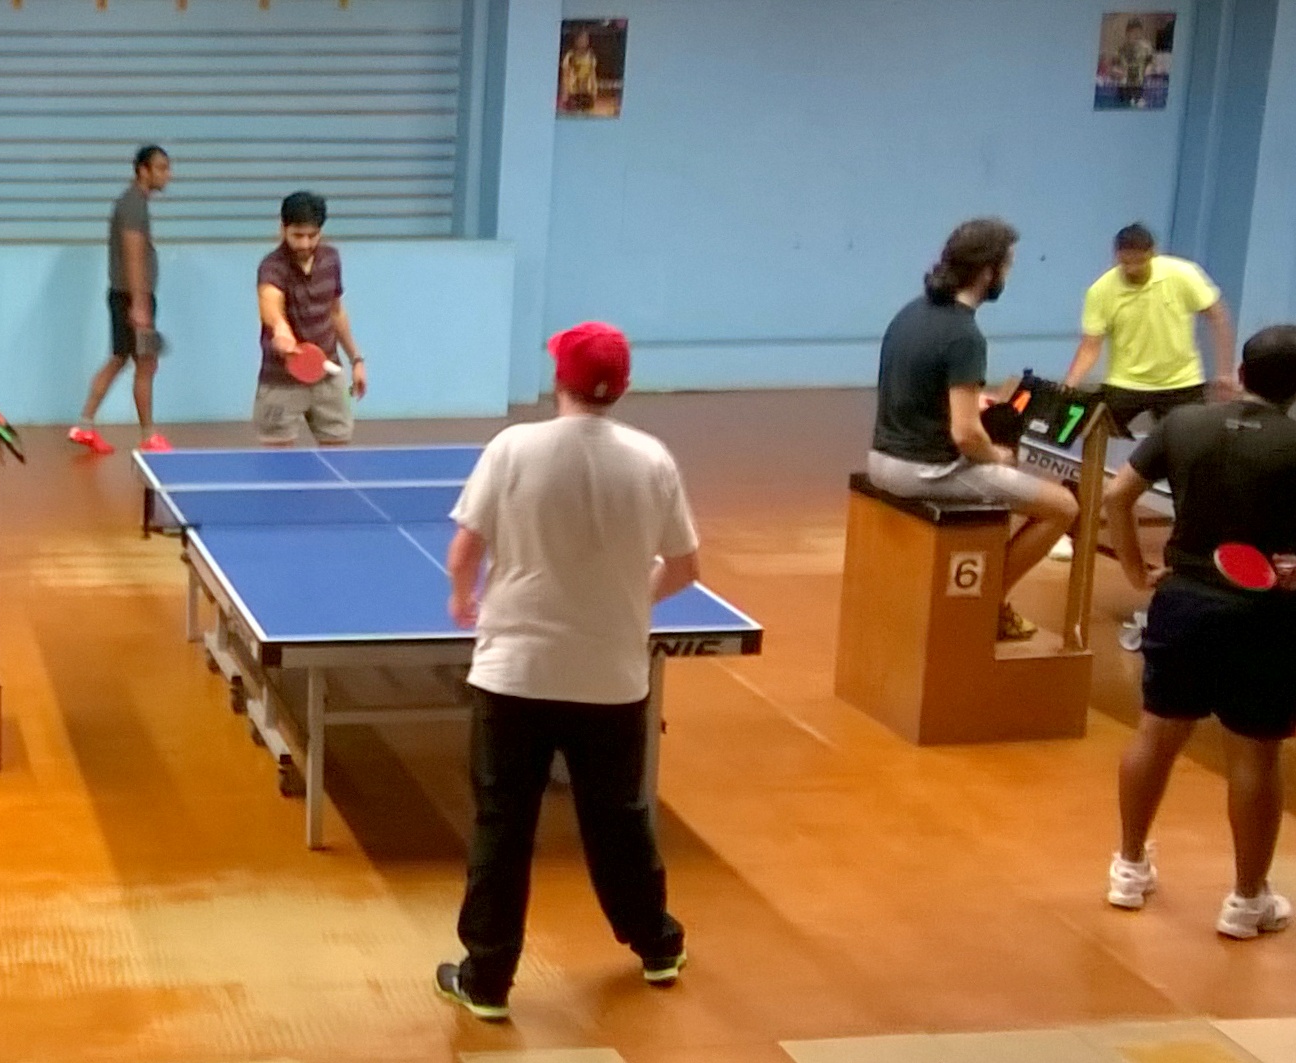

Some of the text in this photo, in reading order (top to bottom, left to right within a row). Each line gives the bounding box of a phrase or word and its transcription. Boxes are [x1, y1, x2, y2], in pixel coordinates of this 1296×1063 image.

[1057, 404, 1084, 443] 7
[1026, 452, 1081, 481] DONIC
[955, 559, 978, 588] 6
